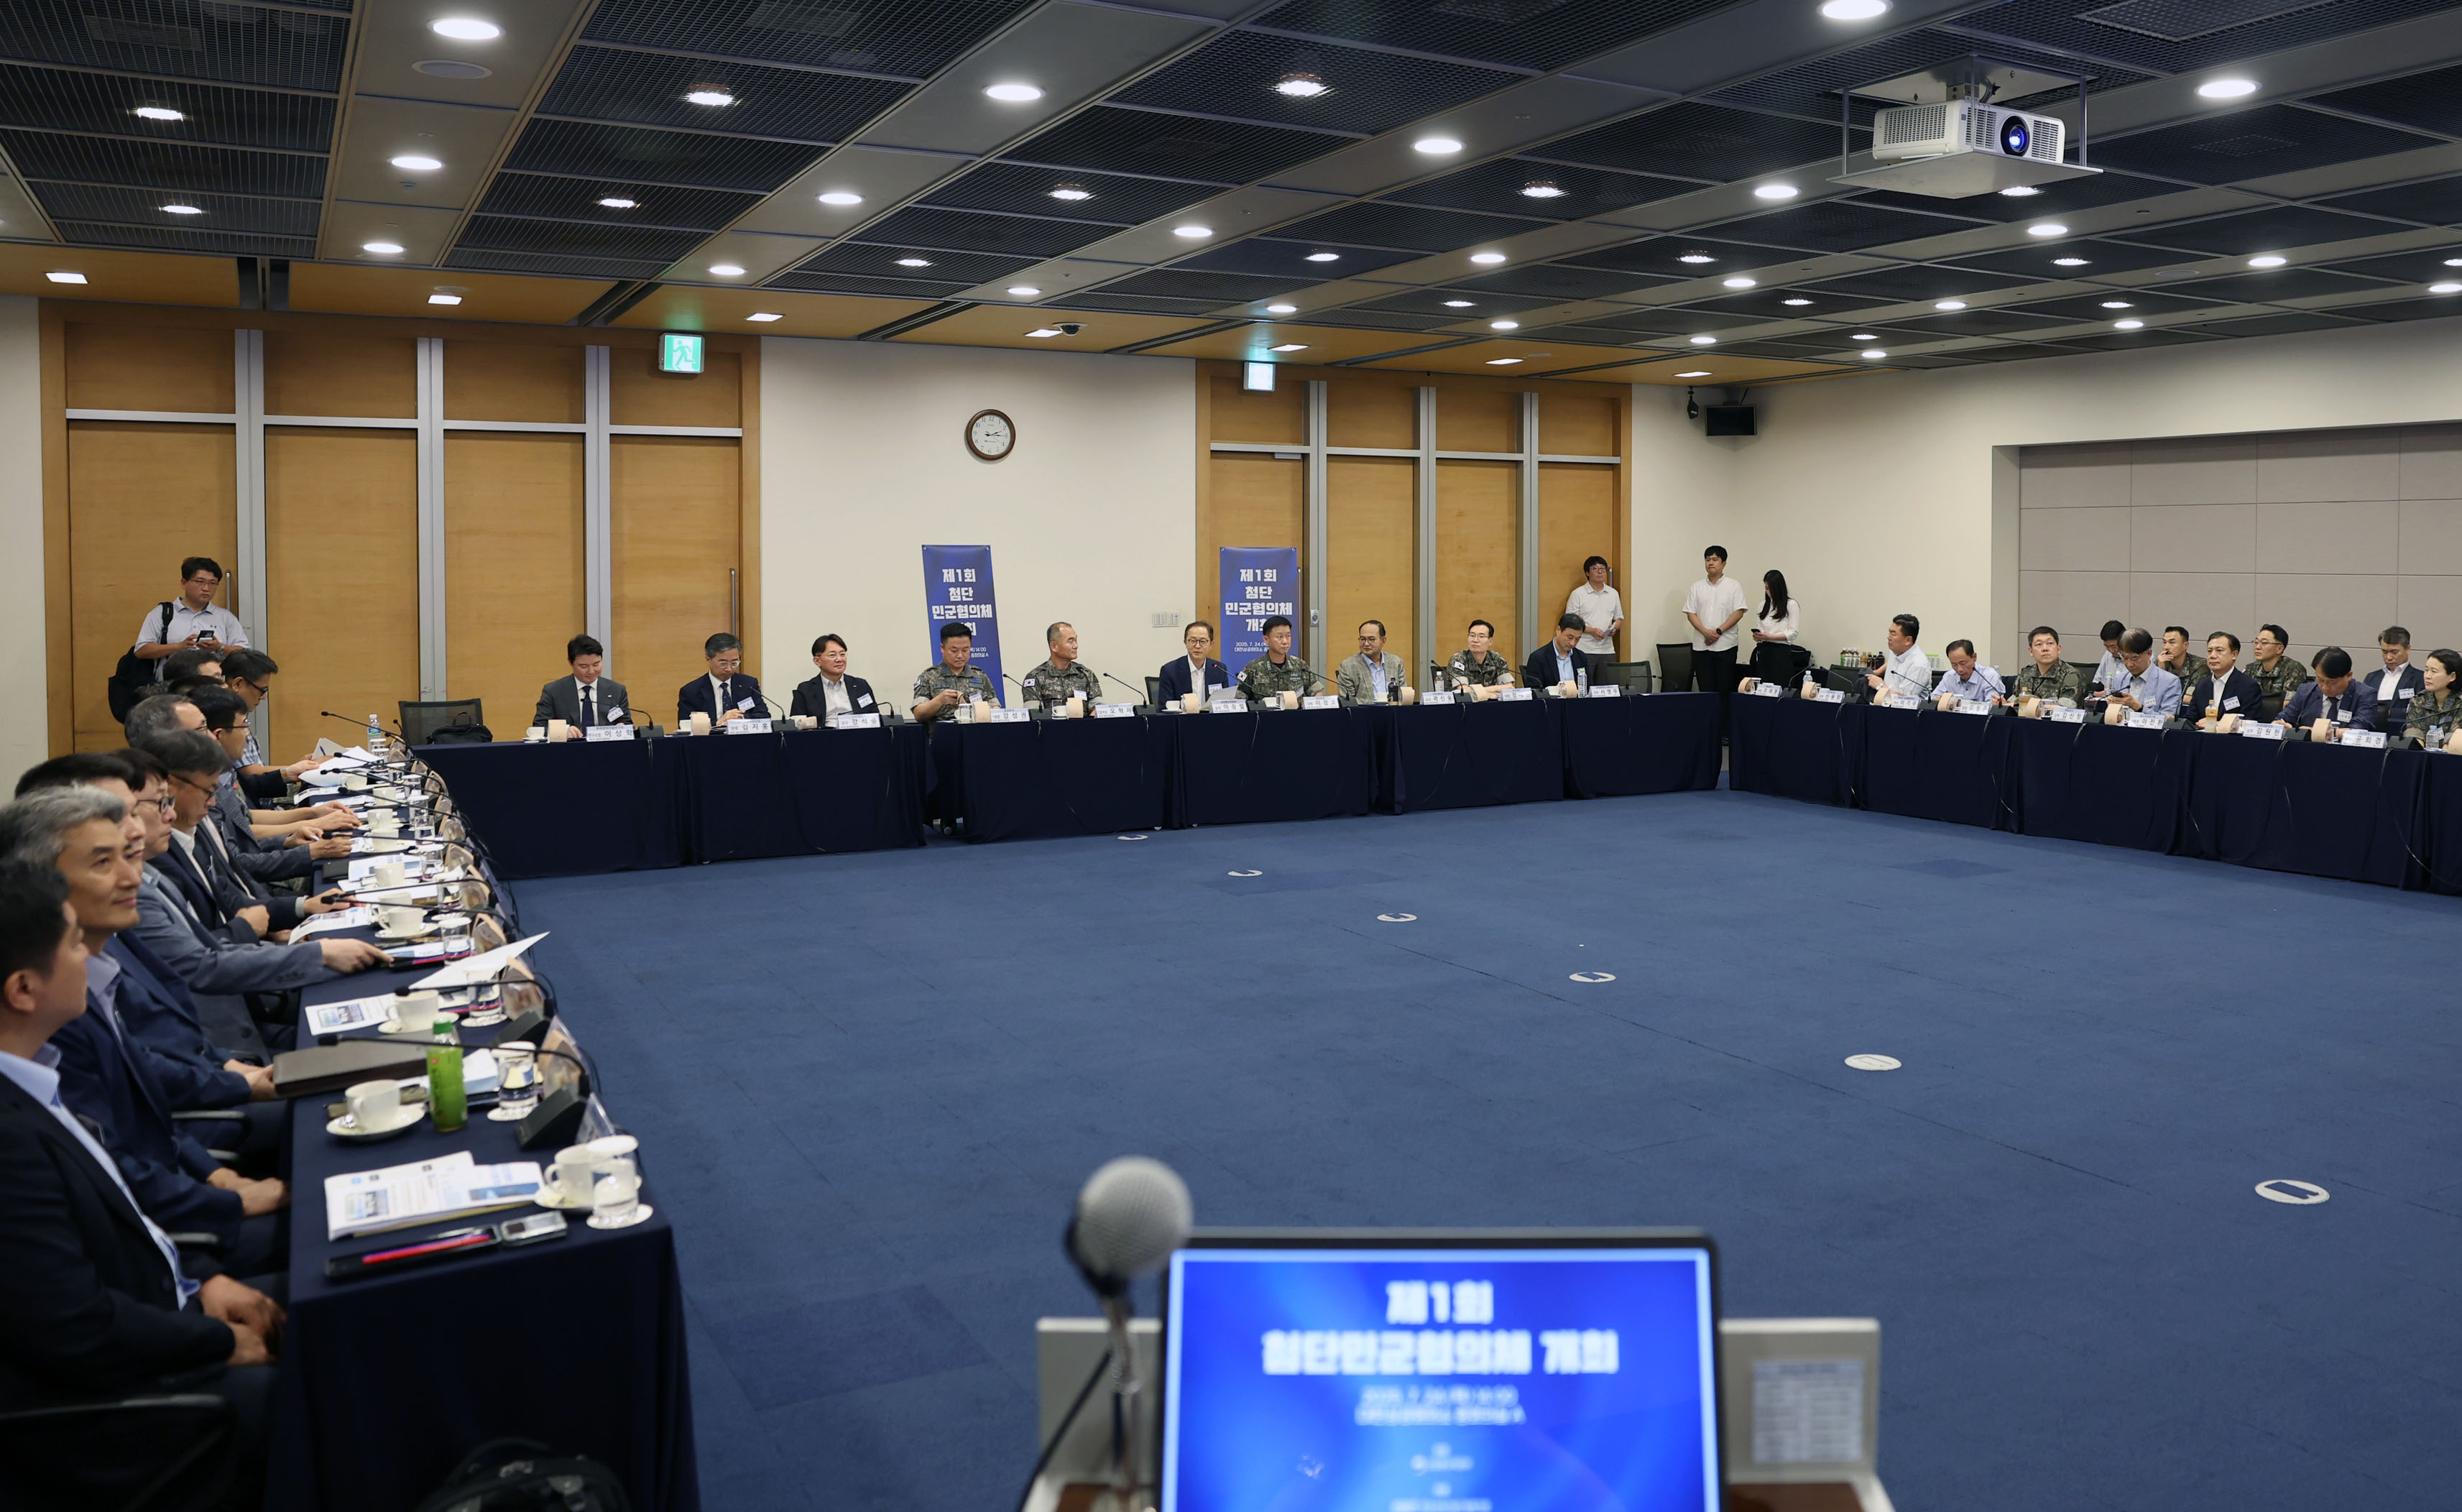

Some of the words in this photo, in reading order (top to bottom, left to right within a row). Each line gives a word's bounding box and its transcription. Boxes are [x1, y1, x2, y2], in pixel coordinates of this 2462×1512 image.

[942, 568, 976, 583] 제1회
[1240, 568, 1277, 582] 제1회
[949, 587, 974, 601] 첨단
[1245, 586, 1273, 599] 첨단
[932, 604, 993, 619] 민군협의체
[1225, 602, 1293, 616] 민군협의체
[604, 728, 633, 738] 이상학
